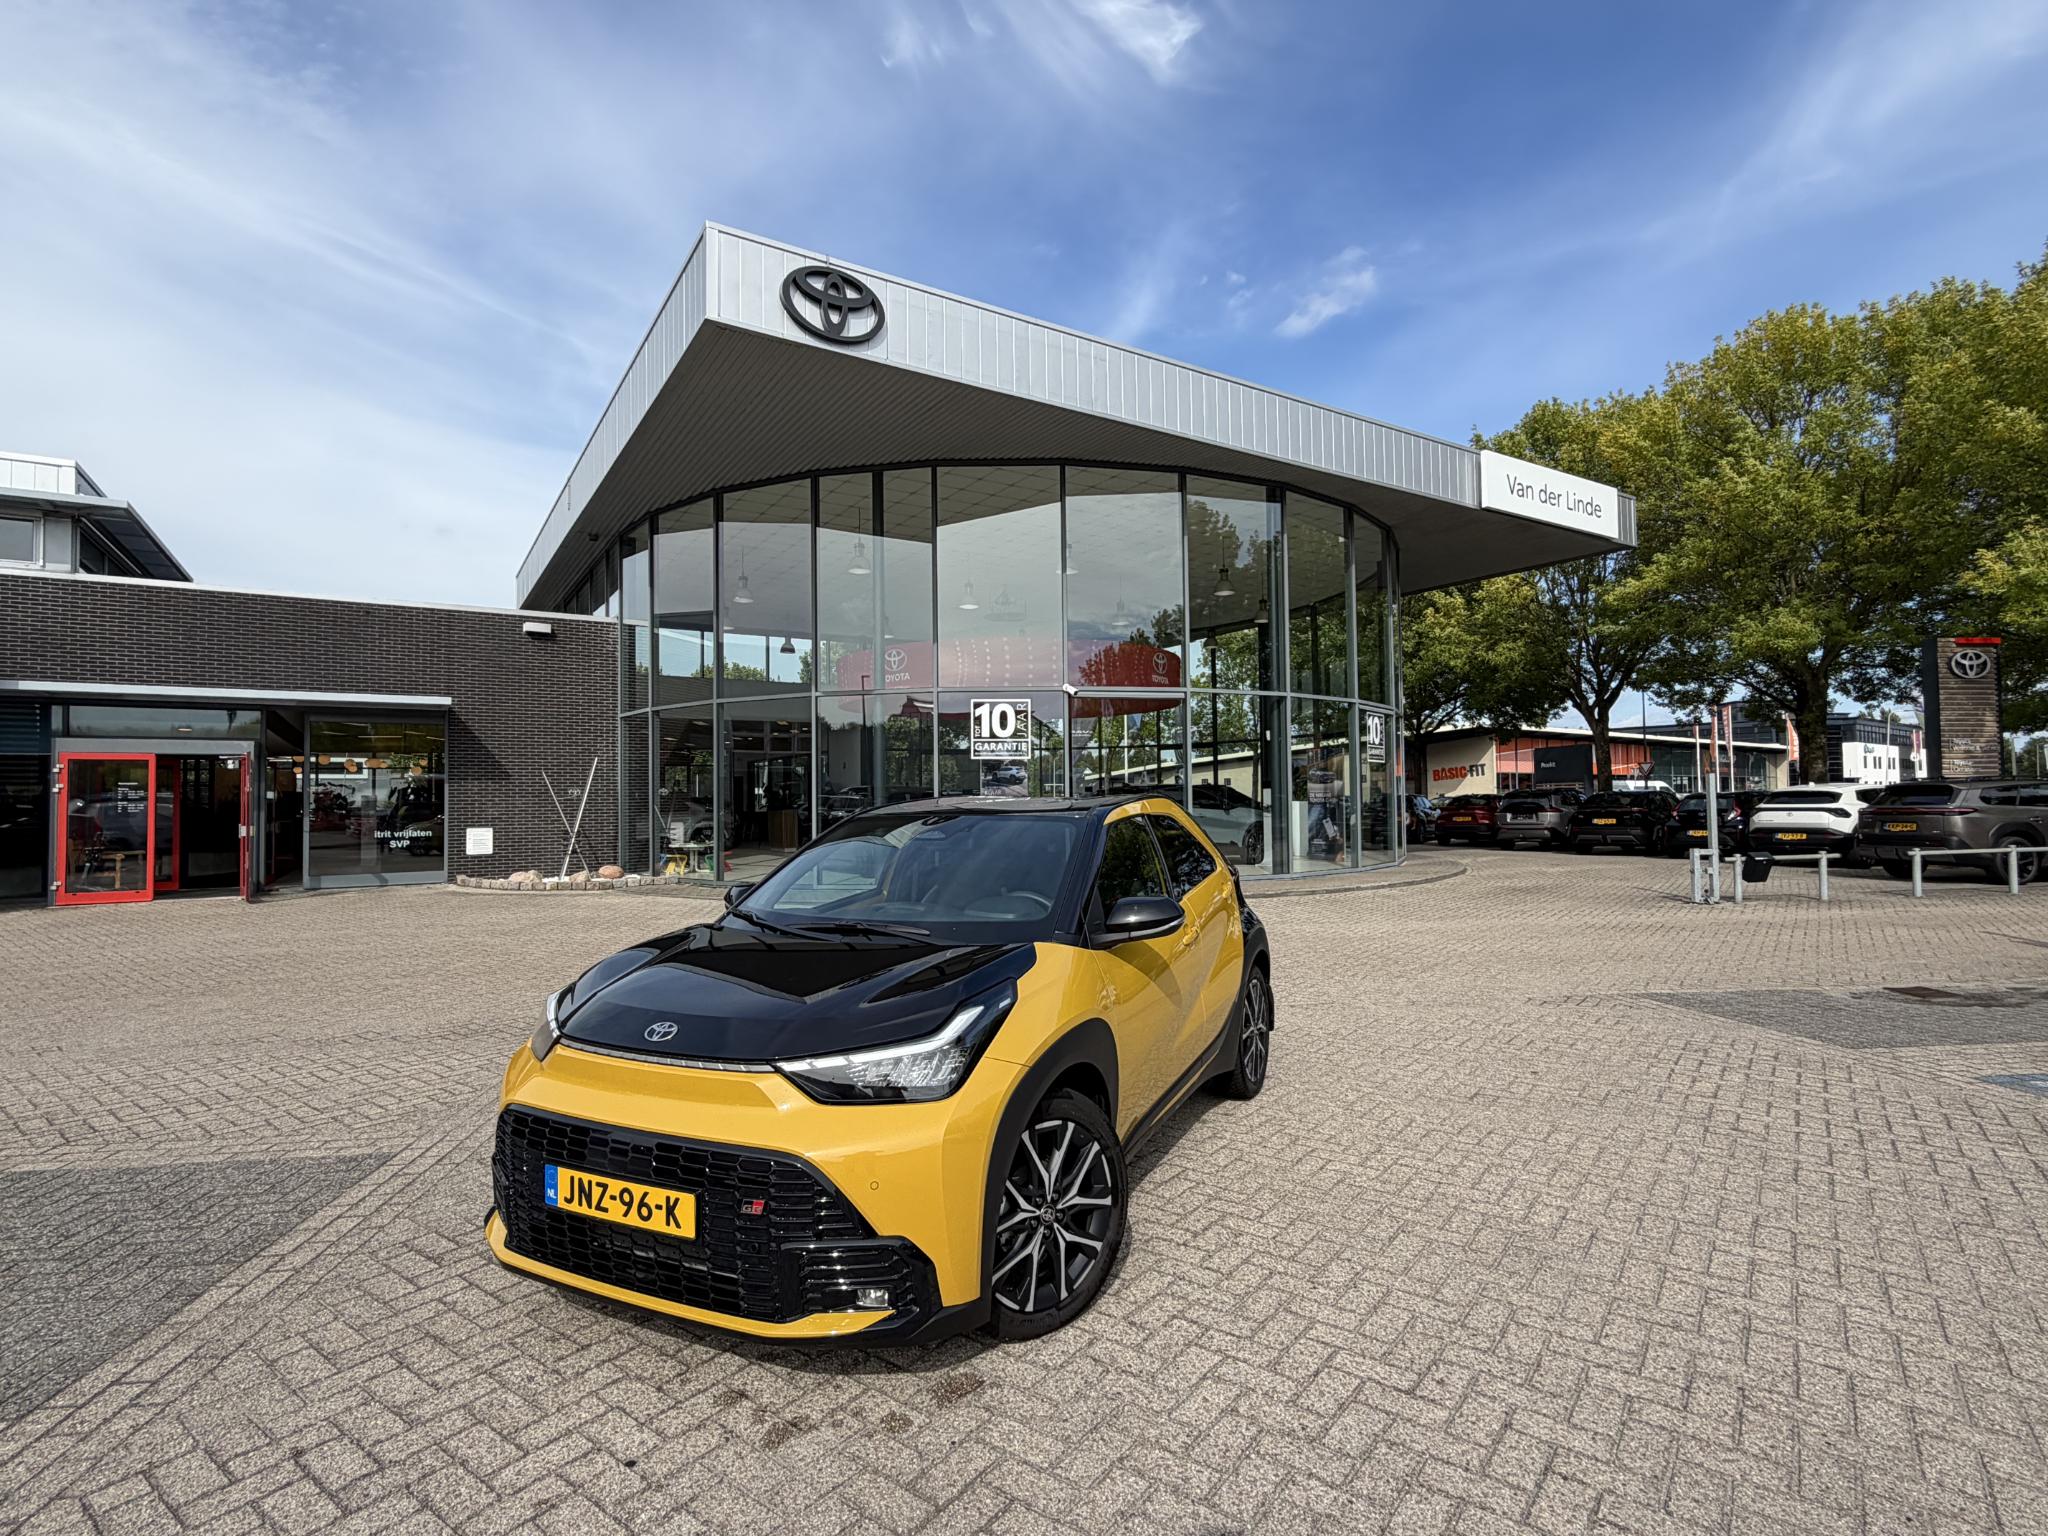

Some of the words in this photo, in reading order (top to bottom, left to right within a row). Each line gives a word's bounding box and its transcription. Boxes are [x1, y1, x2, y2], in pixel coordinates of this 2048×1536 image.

[1506, 474, 1534, 500] Van
[1538, 483, 1562, 507] der
[1566, 490, 1602, 518] Linde
[885, 672, 910, 682] OYOTA
[974, 703, 1016, 738] 10
[1016, 703, 1027, 738] JAAR
[1368, 715, 1380, 745] 10
[974, 742, 1028, 751] GARANTIE
[1432, 763, 1486, 782] BASIC-FIT
[394, 829, 433, 839] vrijlaten
[389, 840, 410, 848] SVP
[547, 1189, 557, 1199] NL
[564, 1175, 682, 1230] JNZ-96-K
[742, 1203, 764, 1214] GR
